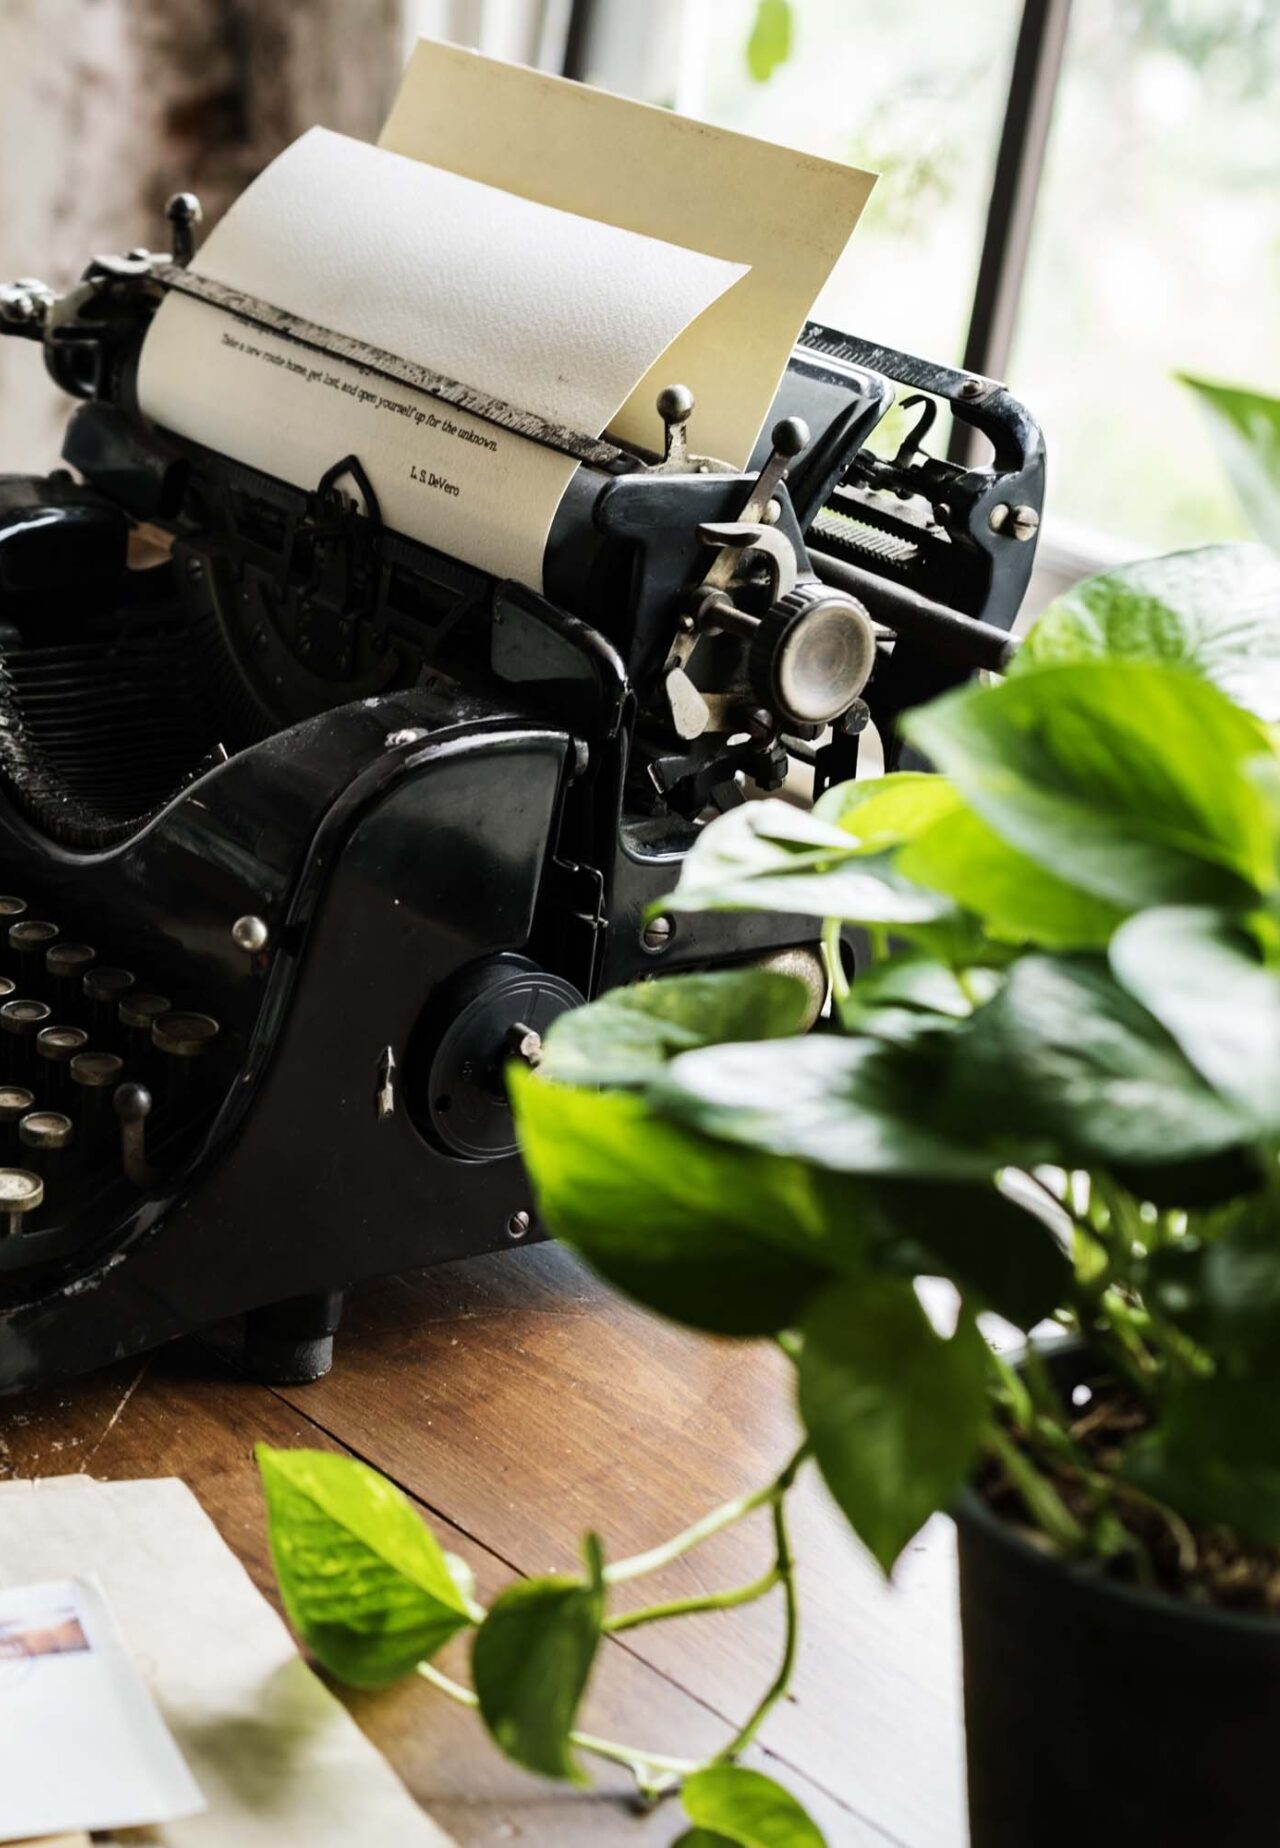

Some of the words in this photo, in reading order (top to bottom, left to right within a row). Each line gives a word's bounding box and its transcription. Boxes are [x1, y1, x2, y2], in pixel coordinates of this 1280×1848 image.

[341, 382, 359, 396] and
[357, 389, 378, 404] open
[375, 397, 417, 418] yourself
[414, 411, 426, 426] up
[425, 414, 442, 428] for
[441, 420, 457, 435] the
[428, 473, 460, 497] DeVero
